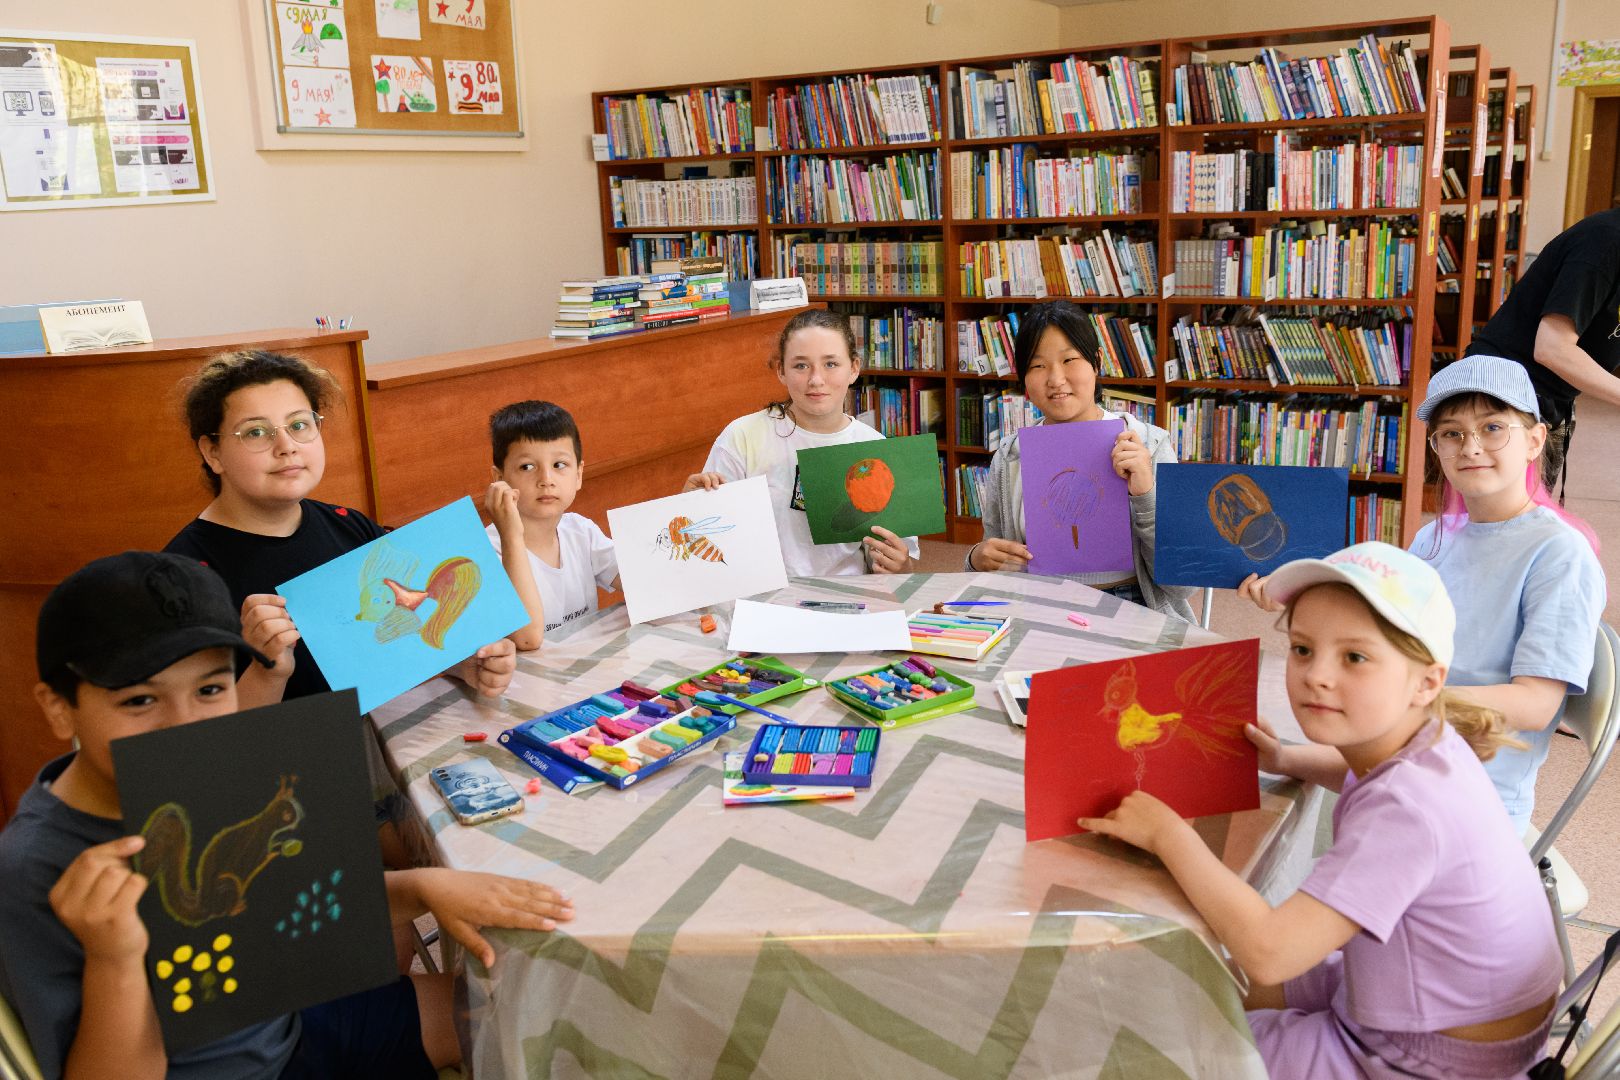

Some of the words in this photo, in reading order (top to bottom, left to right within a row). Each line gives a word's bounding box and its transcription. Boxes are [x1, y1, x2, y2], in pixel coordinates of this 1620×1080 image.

[291, 79, 300, 101] 9
[460, 73, 474, 102] 9
[65, 304, 126, 317] АБОНЕМЕНТ
